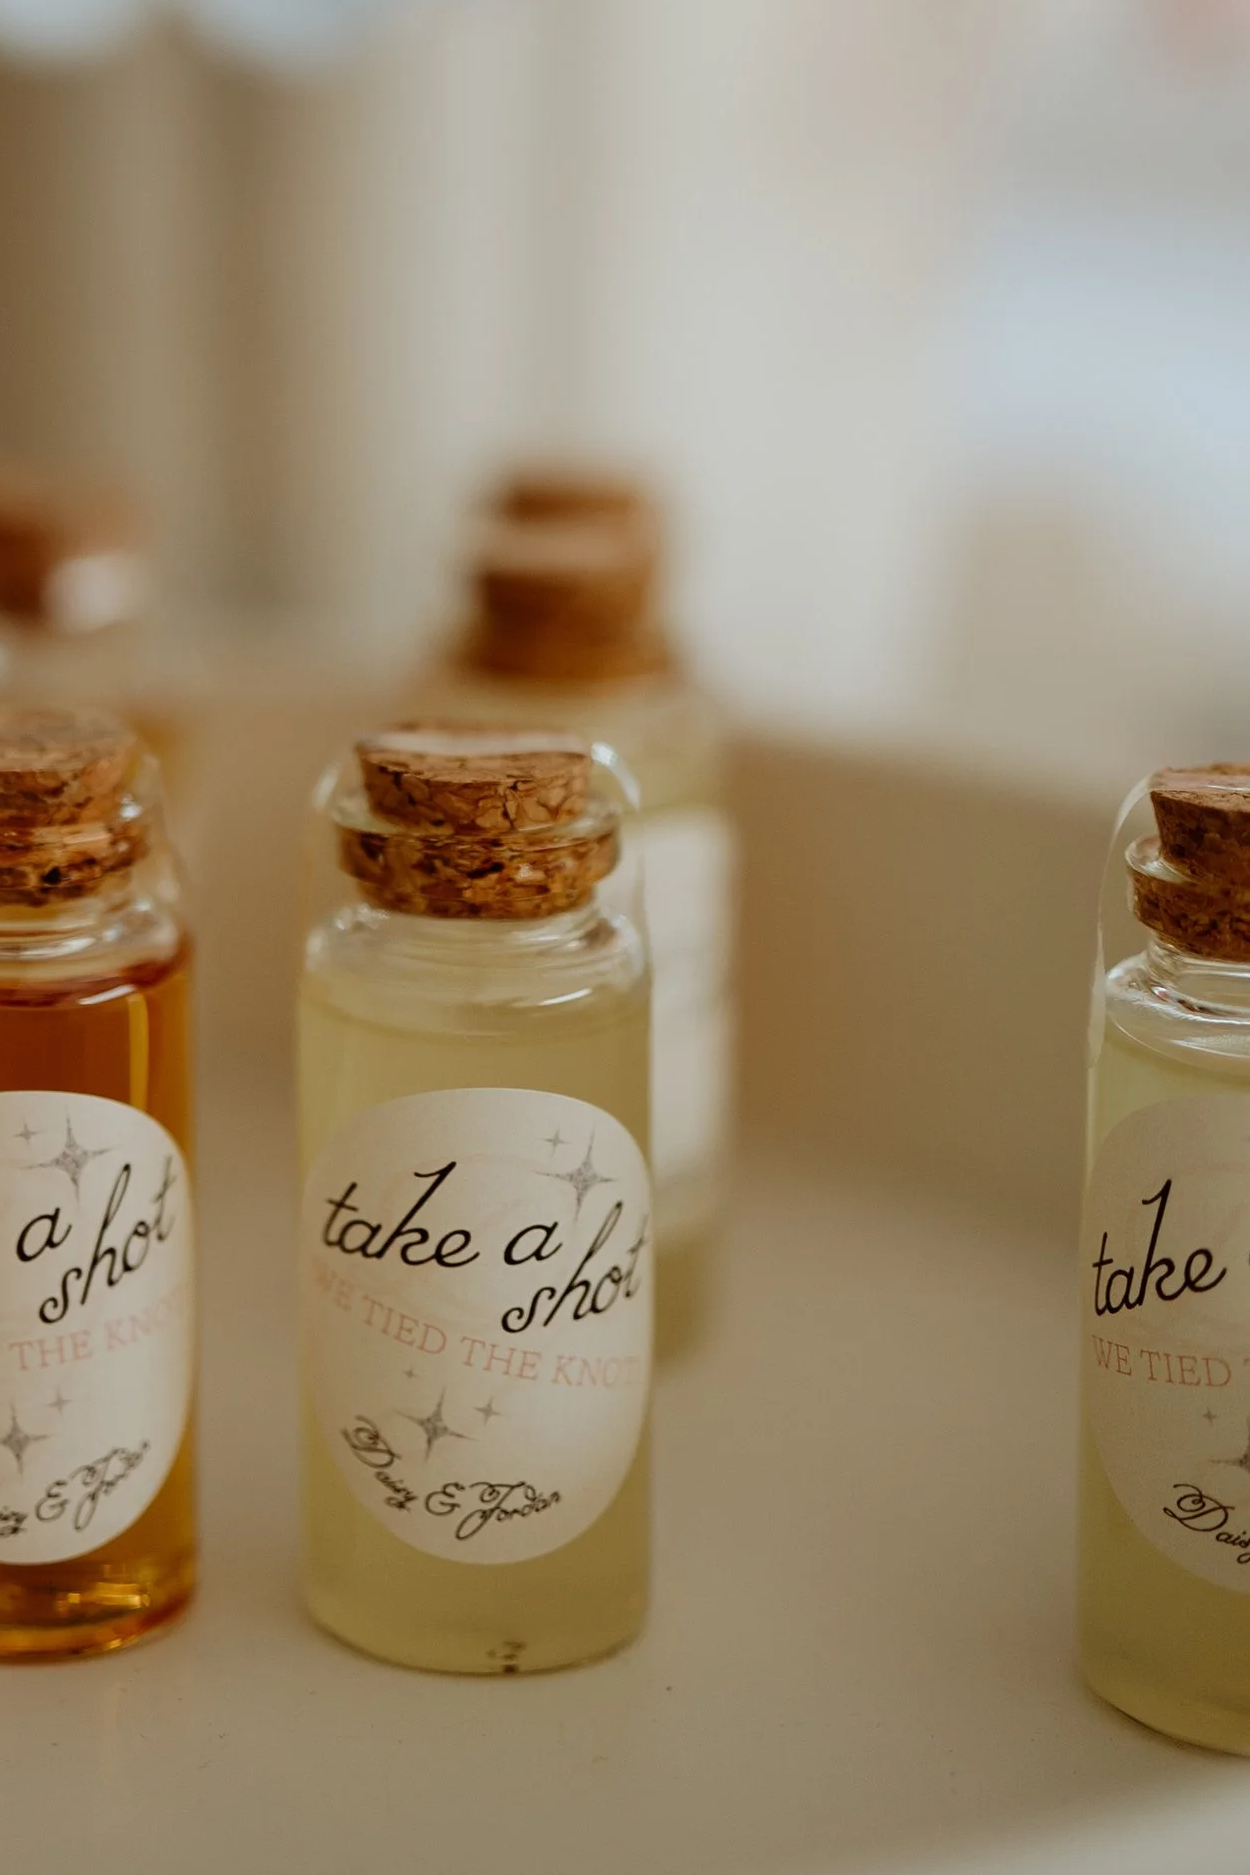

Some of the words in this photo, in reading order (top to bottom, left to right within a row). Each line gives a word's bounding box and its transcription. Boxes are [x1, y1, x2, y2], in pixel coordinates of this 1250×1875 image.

[16, 1207, 72, 1263] a
[39, 1155, 178, 1324] shot
[323, 1161, 480, 1268] take
[503, 1220, 562, 1266] a
[1092, 1179, 1228, 1316] take
[501, 1201, 648, 1333] shot
[9, 1330, 93, 1372] THE
[361, 1293, 448, 1355] TIED
[459, 1336, 542, 1382] THE
[1091, 1334, 1133, 1378] WE
[1140, 1348, 1232, 1389] TIED
[36, 1480, 70, 1522] &
[341, 1415, 419, 1514] Daisy
[425, 1482, 466, 1516] &
[455, 1481, 562, 1541] Jordan
